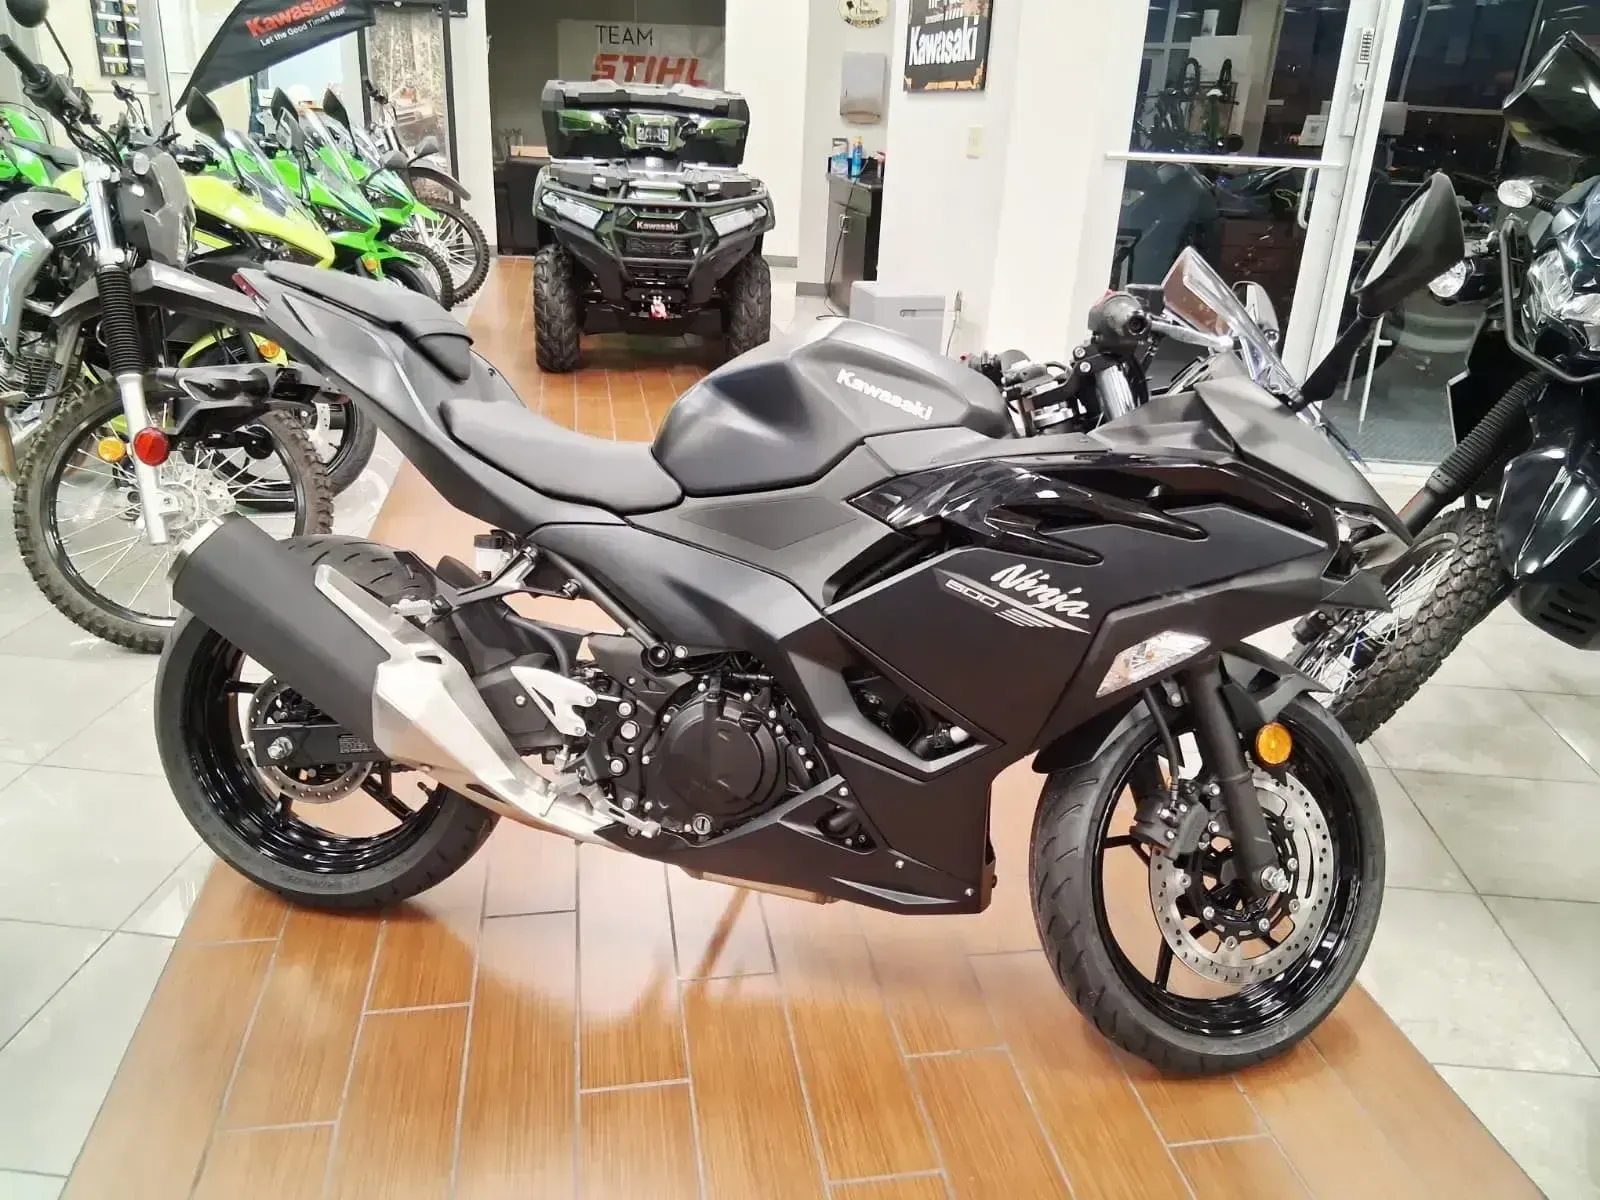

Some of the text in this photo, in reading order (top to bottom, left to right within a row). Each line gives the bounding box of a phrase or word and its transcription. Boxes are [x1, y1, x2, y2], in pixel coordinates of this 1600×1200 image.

[245, 0, 344, 37] Kawasa
[260, 36, 274, 47] Let
[274, 31, 288, 41] the
[287, 23, 308, 36] Good
[594, 24, 654, 46] TEAM
[908, 14, 980, 66] Kawasaki
[591, 53, 710, 88] STIHL
[636, 220, 679, 231] Kawasaki
[836, 368, 933, 420] Kawasaki
[945, 578, 1000, 608] 500
[990, 563, 1090, 619] Ninja
